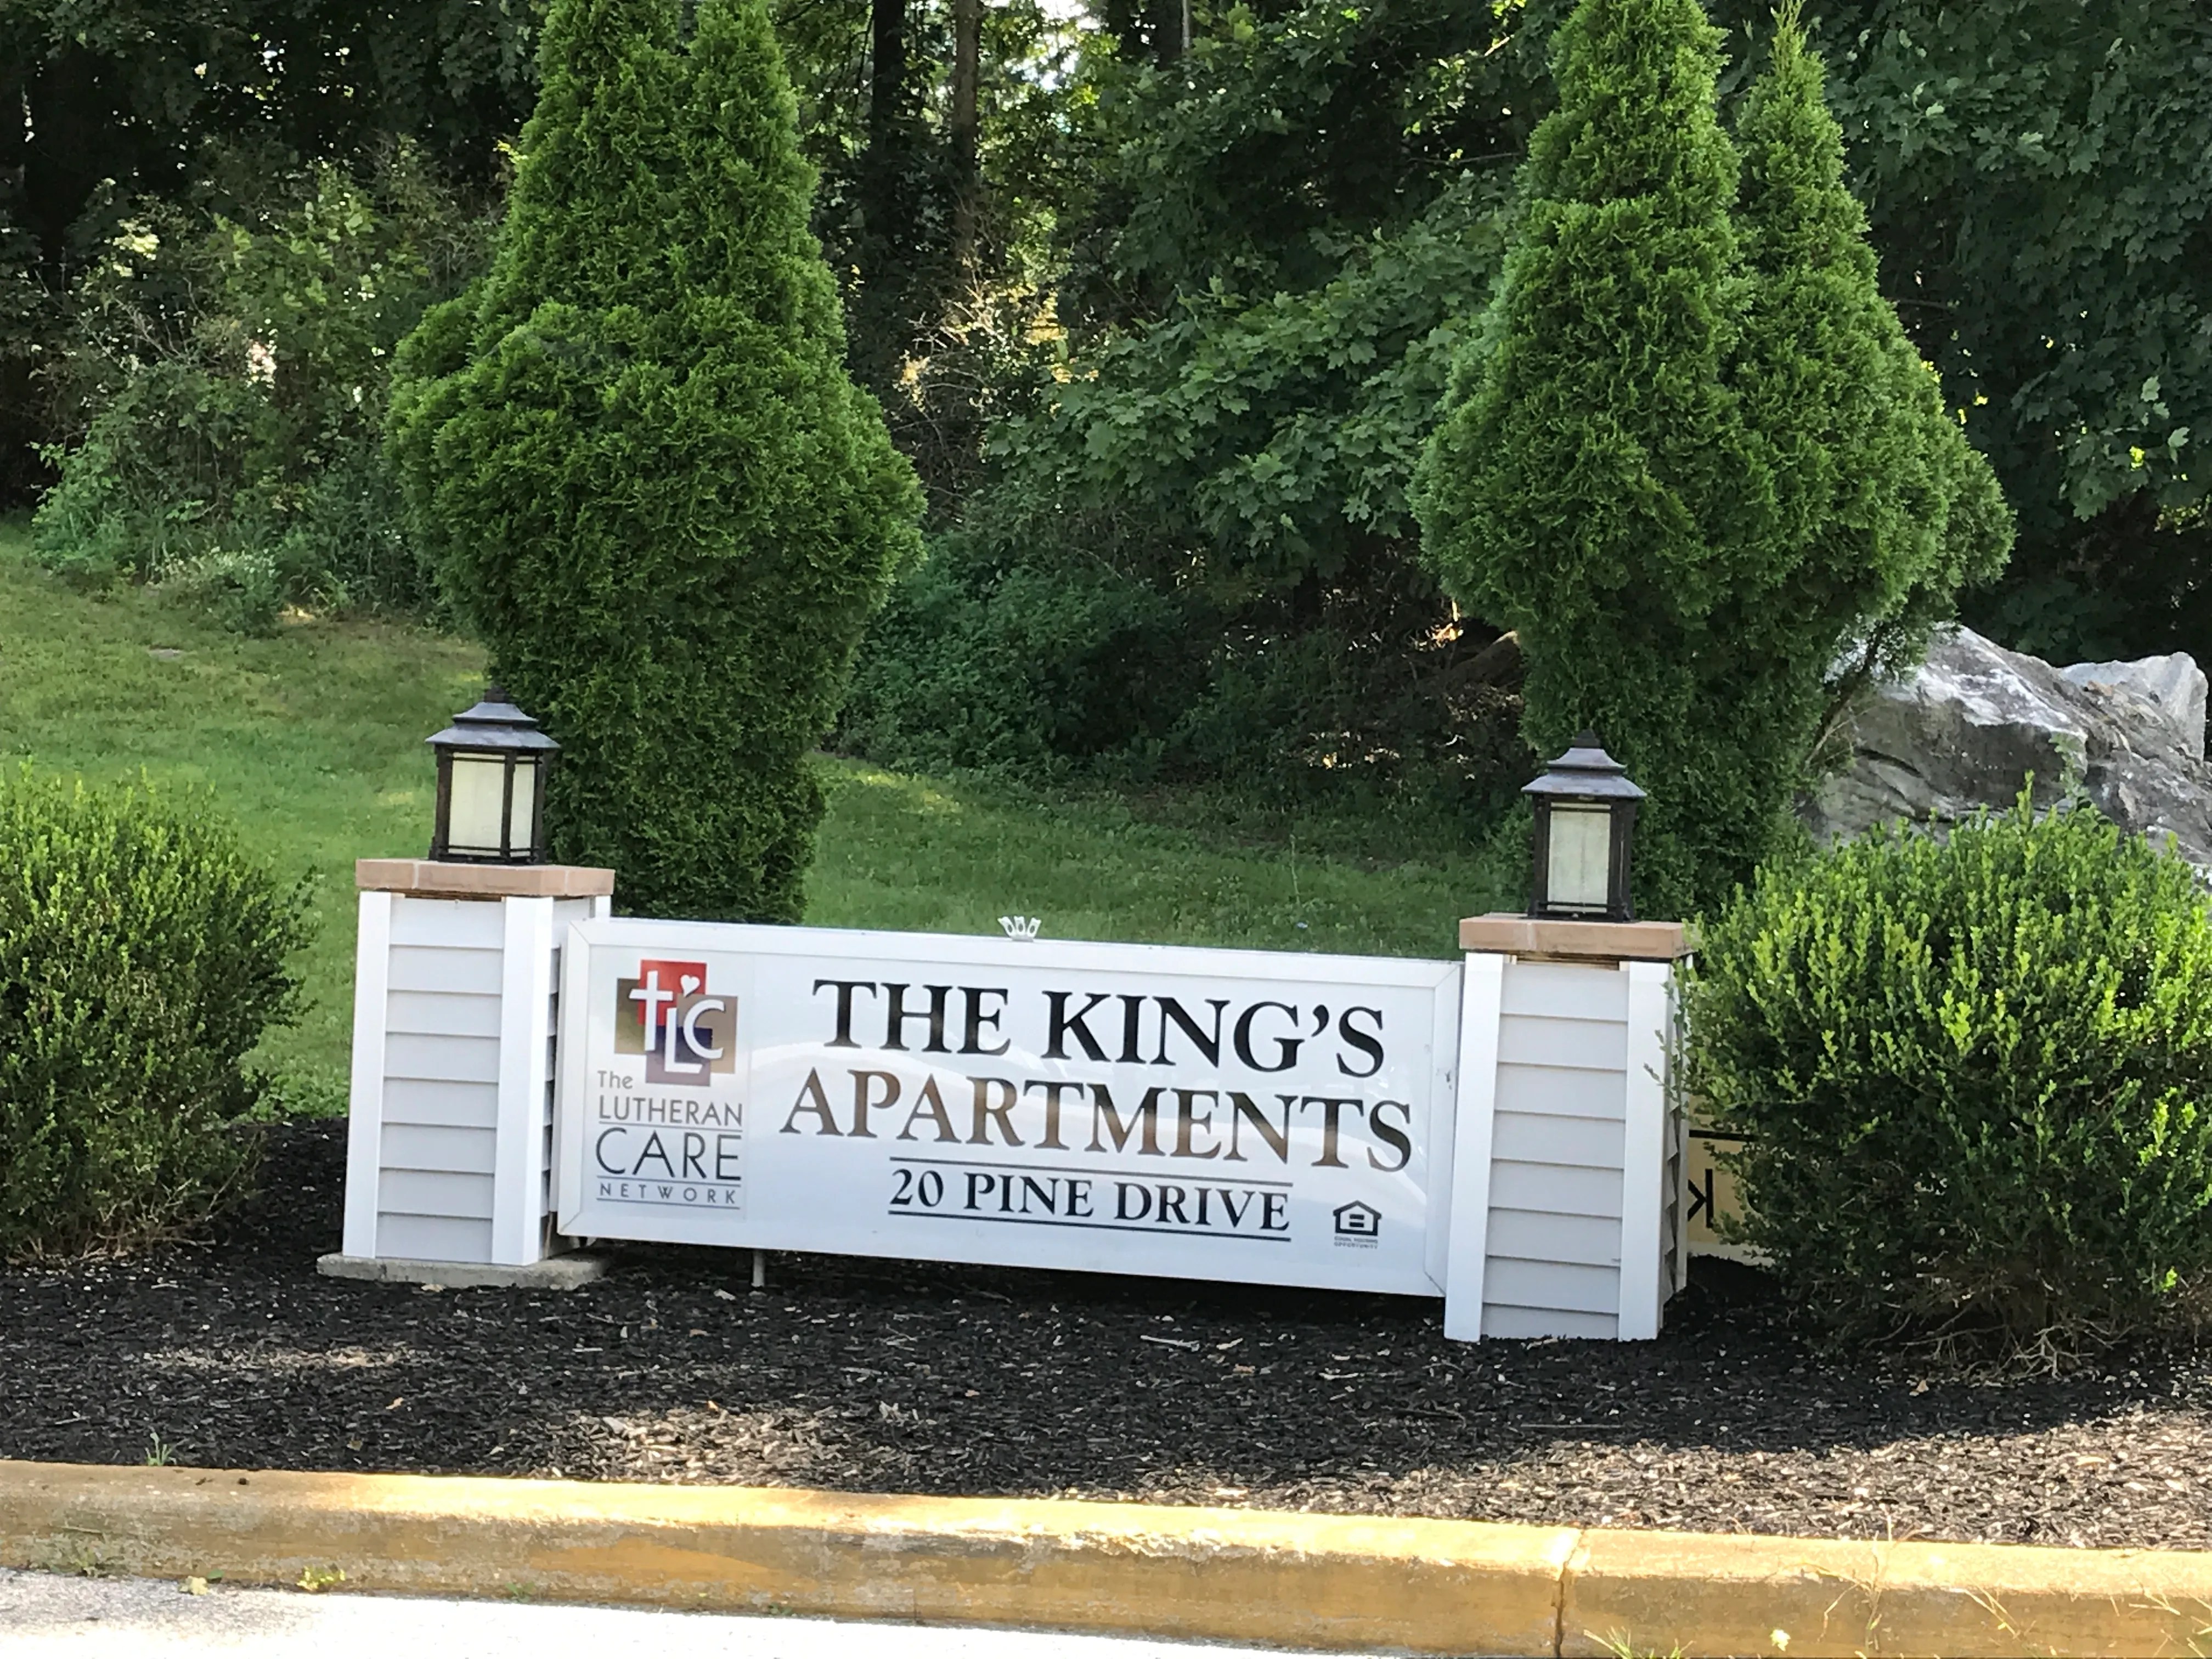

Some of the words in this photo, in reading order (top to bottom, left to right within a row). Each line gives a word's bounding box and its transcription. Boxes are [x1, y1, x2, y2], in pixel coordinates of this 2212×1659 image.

[811, 979, 1012, 1057] THE
[1040, 990, 1385, 1079] KING'S
[597, 1070, 634, 1090] The
[599, 1094, 743, 1127] LUTHERAN
[778, 1066, 1413, 1173] APARTMENTS
[595, 1126, 743, 1182] CARE
[599, 1183, 736, 1204] NETWORK
[889, 1168, 944, 1208] 20
[963, 1171, 1095, 1218] PINE
[1113, 1181, 1290, 1232] DRIVE
